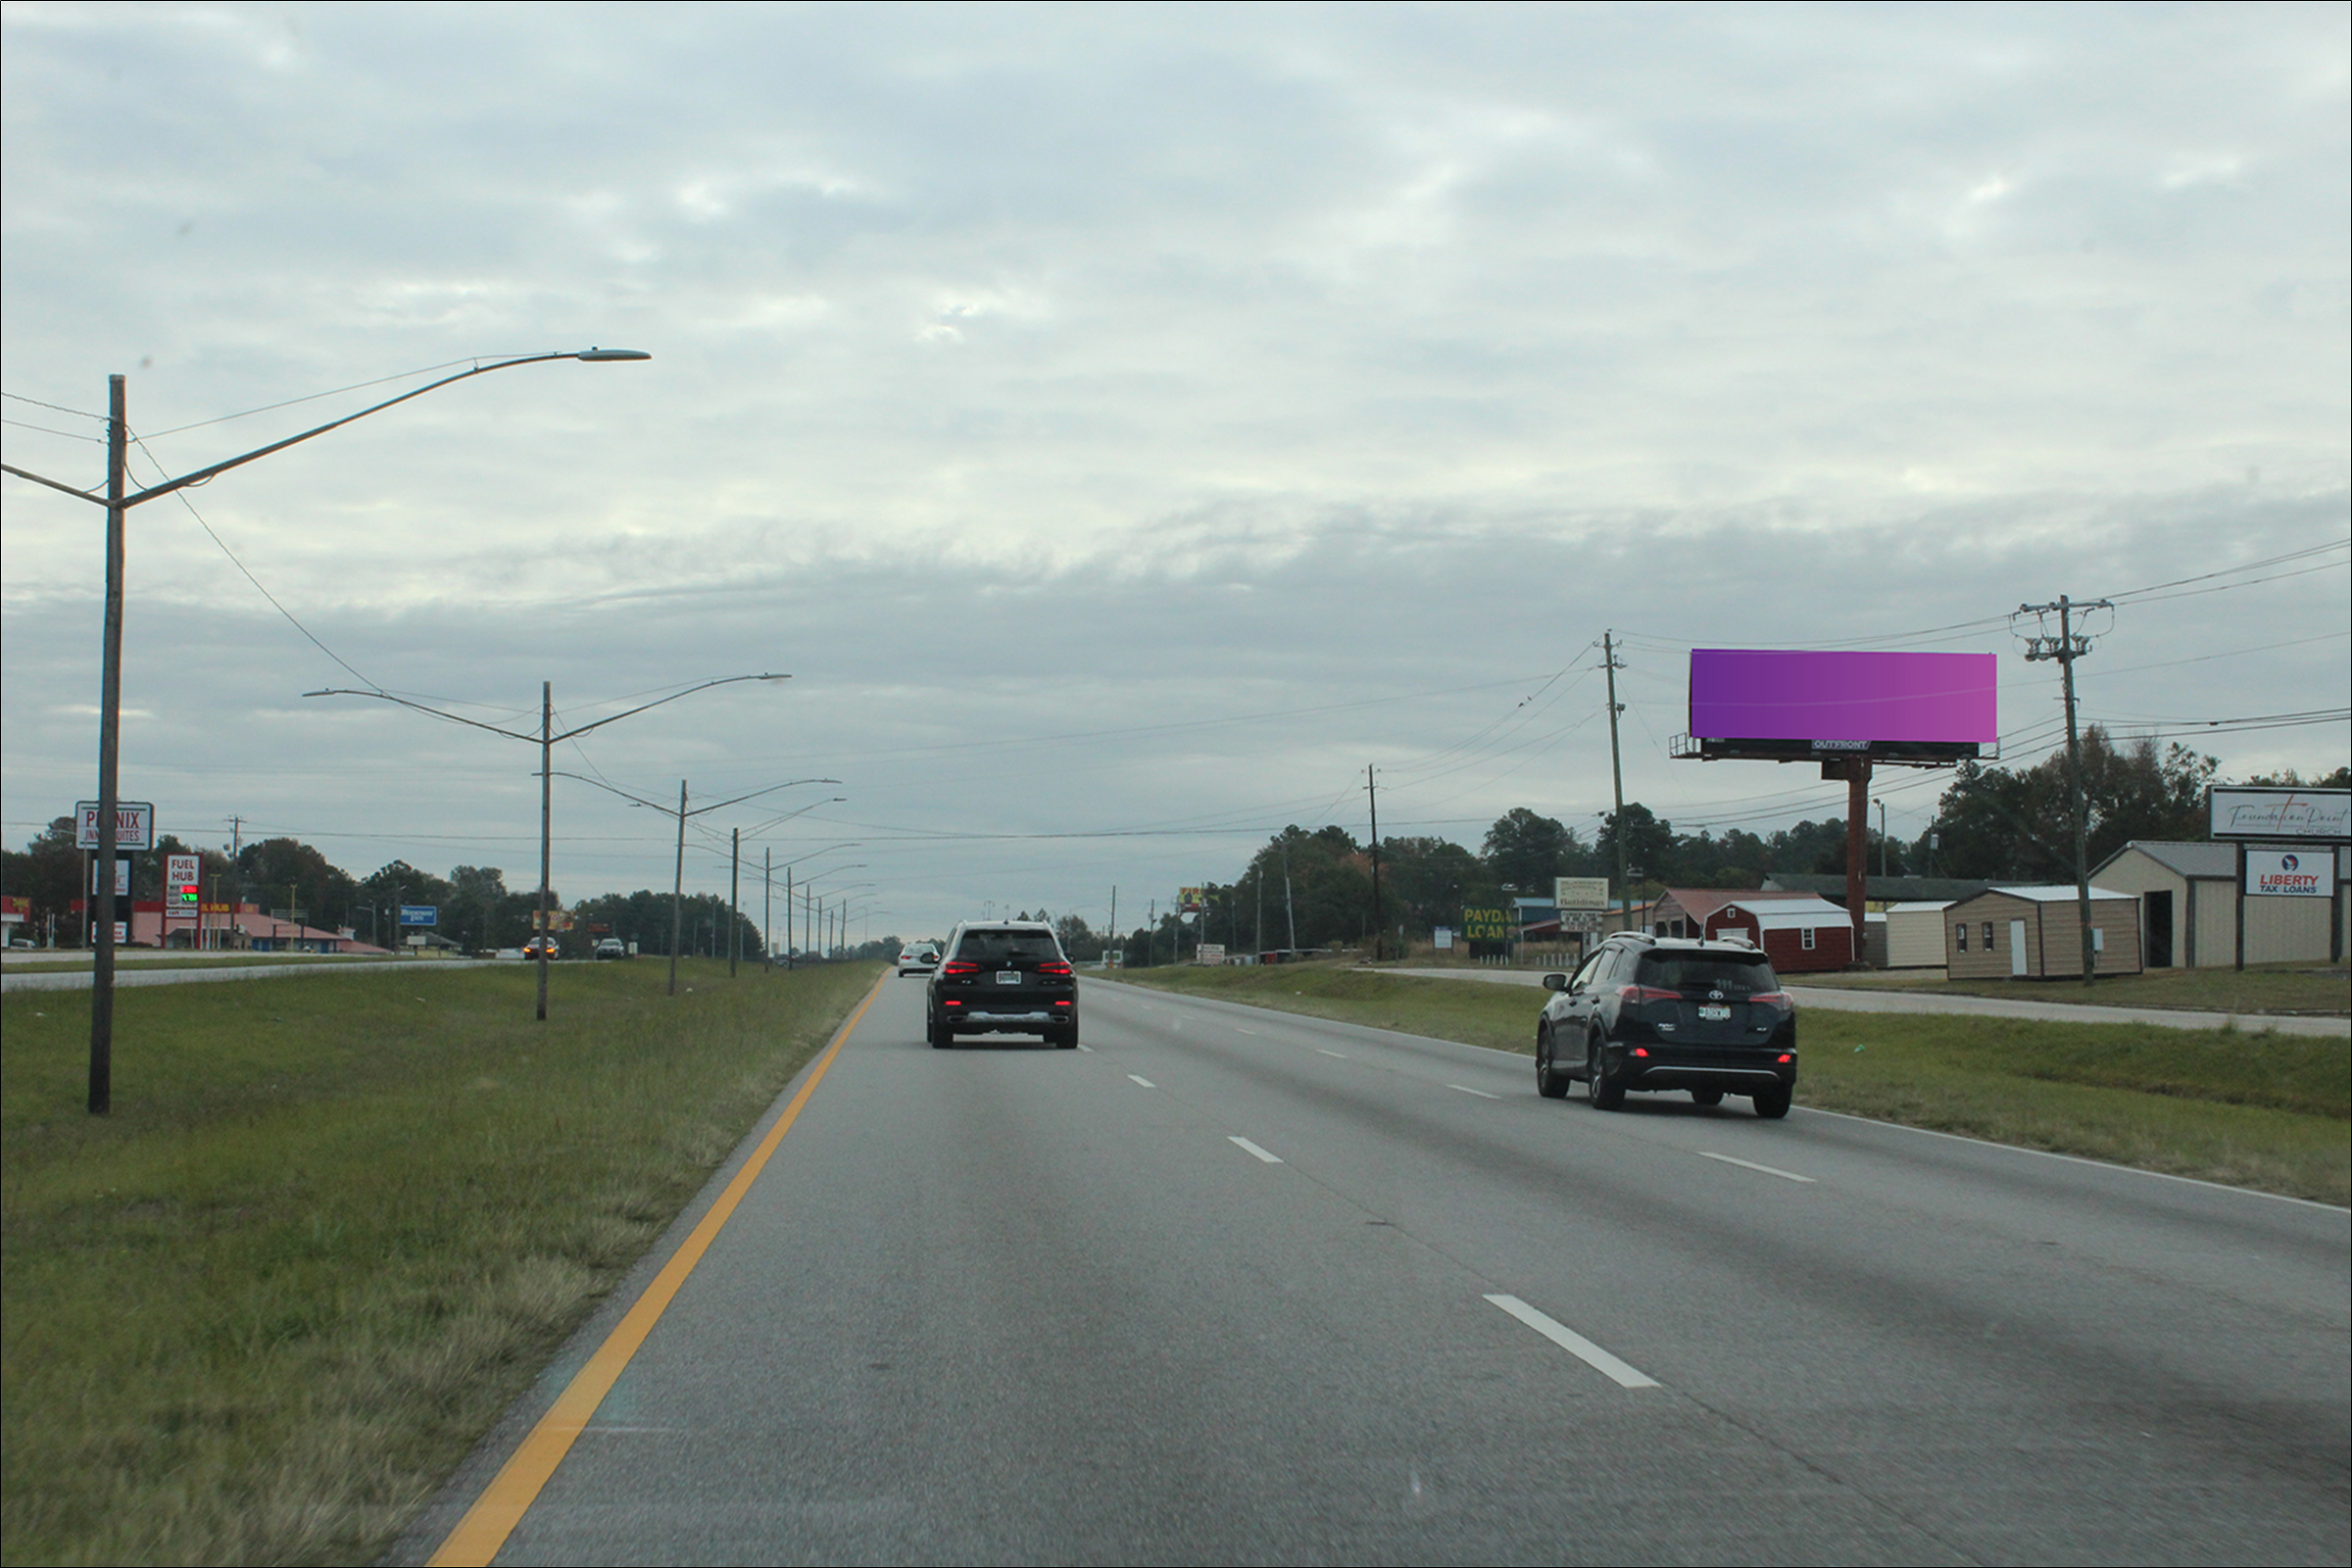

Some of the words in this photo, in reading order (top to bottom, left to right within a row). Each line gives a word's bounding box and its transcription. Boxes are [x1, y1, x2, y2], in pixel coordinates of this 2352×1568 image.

[1814, 739, 1868, 749] OUTFRONT
[86, 810, 140, 828] PNIX
[113, 829, 140, 841] UITES
[172, 859, 194, 869] FUEL
[172, 871, 194, 881] HUB
[2260, 874, 2319, 886] LIBERTY
[2282, 885, 2317, 894] LOANS
